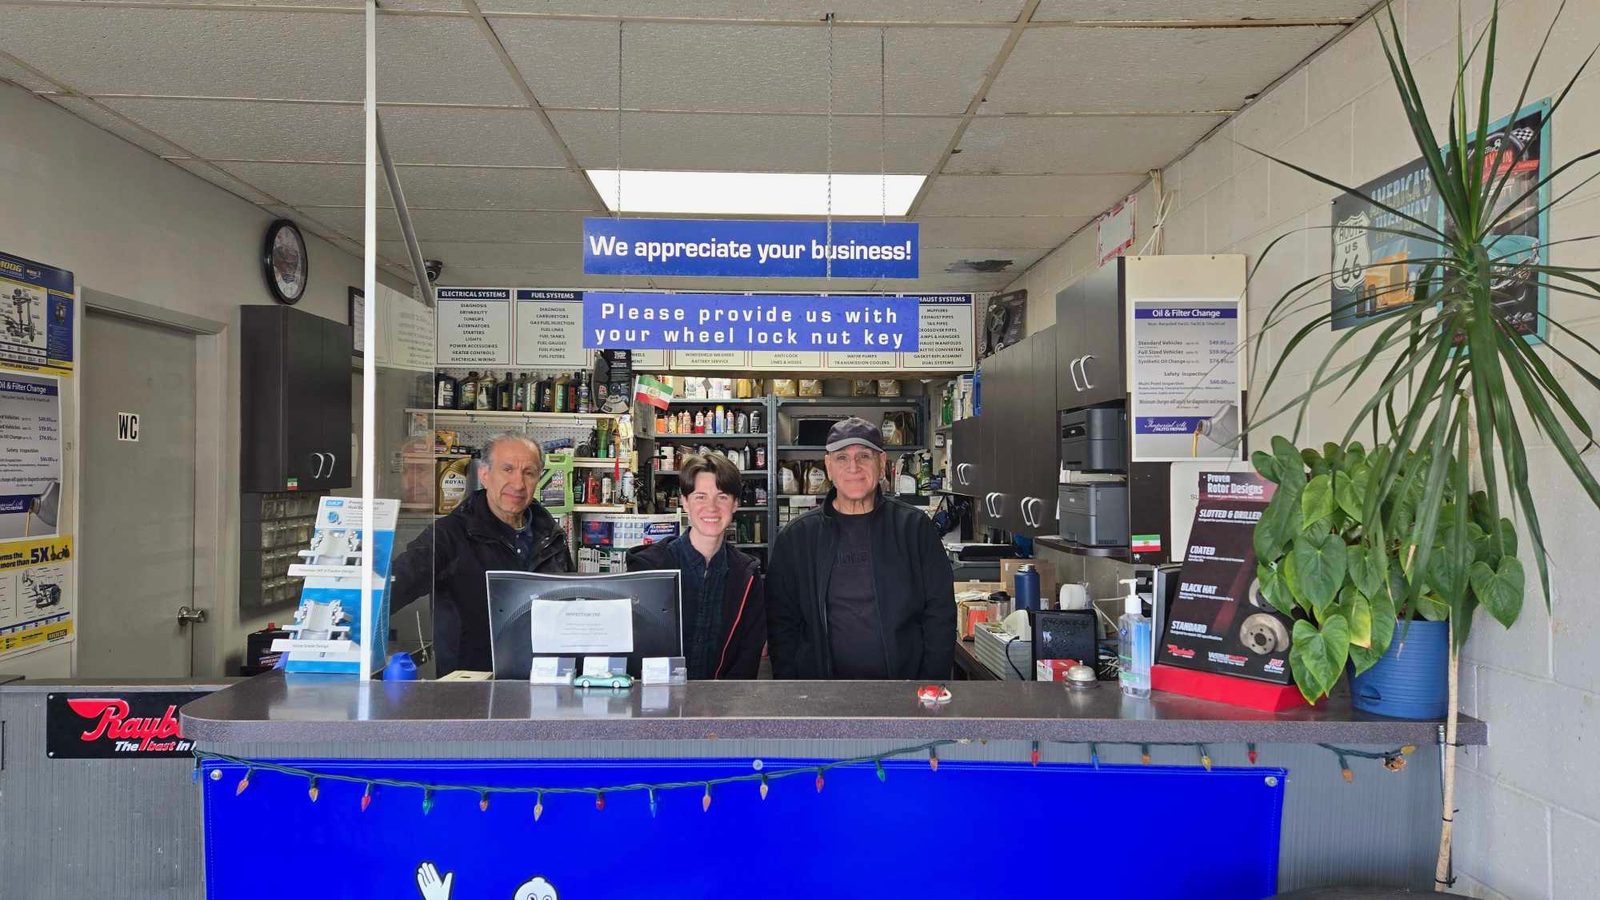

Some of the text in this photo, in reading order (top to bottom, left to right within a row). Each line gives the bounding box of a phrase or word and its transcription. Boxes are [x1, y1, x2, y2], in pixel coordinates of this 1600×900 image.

[589, 235, 912, 264] We appreciate your business!
[1345, 242, 1358, 254] US
[1342, 254, 1361, 283] 66
[601, 303, 897, 324] Please provide us with
[1152, 309, 1164, 317] Oil
[1171, 309, 1191, 317] Filter
[1191, 309, 1220, 319] Change
[595, 326, 903, 349] your wheel lock nut key
[12, 383, 26, 391] Filter
[26, 384, 47, 394] Change
[119, 414, 138, 440] WC
[1207, 474, 1230, 483] Proven
[1207, 482, 1264, 496] Rotor Designs
[1199, 509, 1263, 520] SLOTTED & DRILLED
[31, 546, 50, 564] 5X
[1190, 545, 1216, 556] COATED
[16, 559, 30, 567] than
[1180, 582, 1218, 595] BLACK HAT
[1171, 620, 1208, 634] STANDARD
[67, 698, 183, 751] Rayb
[115, 740, 140, 751] The
